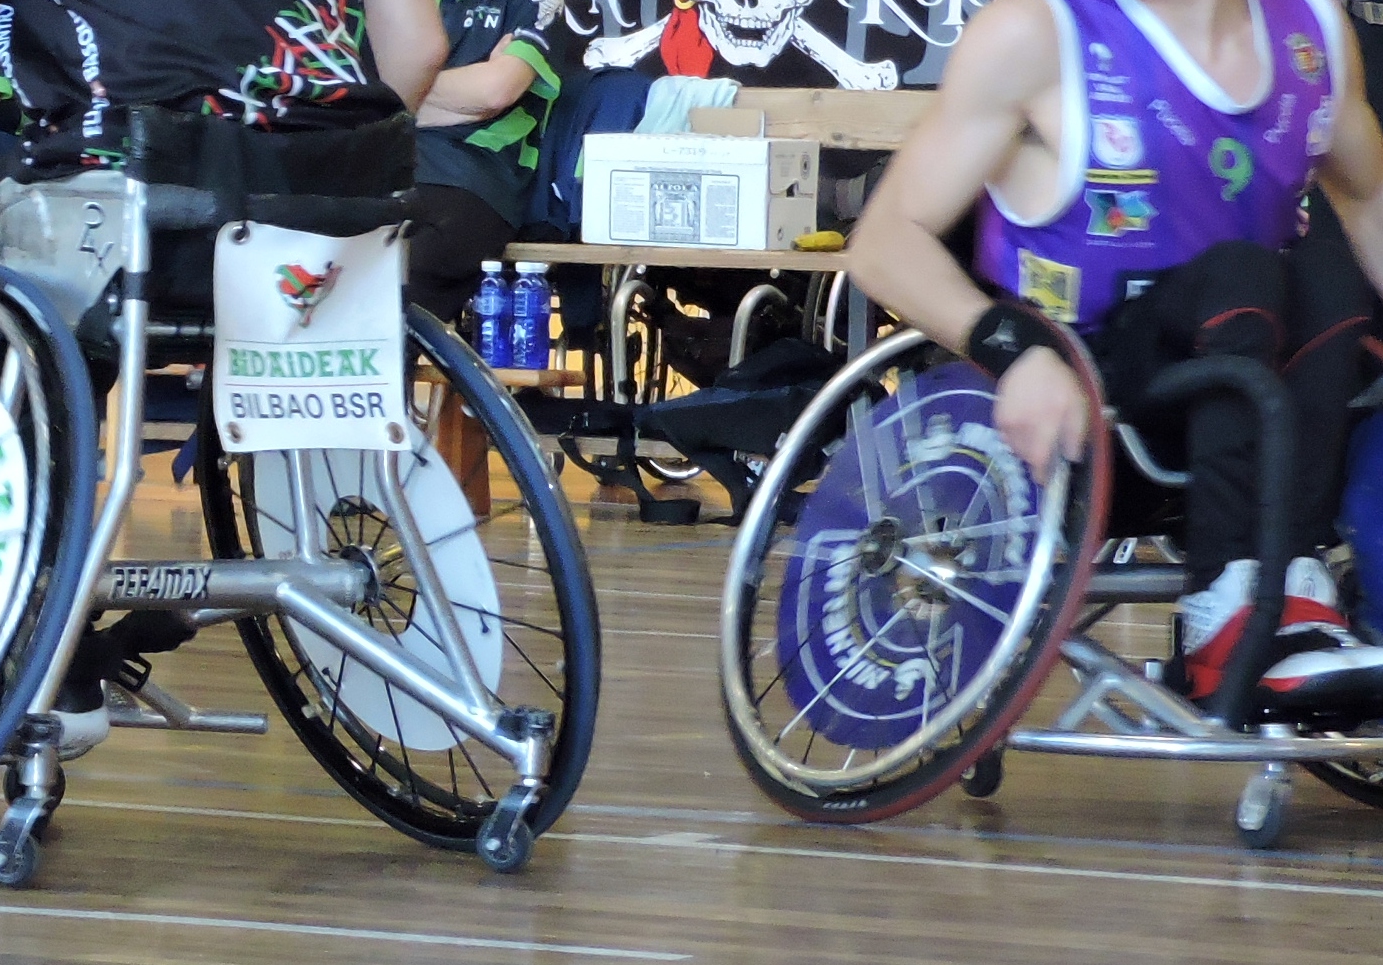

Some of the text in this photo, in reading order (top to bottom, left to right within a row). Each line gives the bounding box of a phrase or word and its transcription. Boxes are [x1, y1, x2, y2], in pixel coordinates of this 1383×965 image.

[1207, 136, 1255, 202] 9
[231, 392, 386, 419] BILBAO BSR
